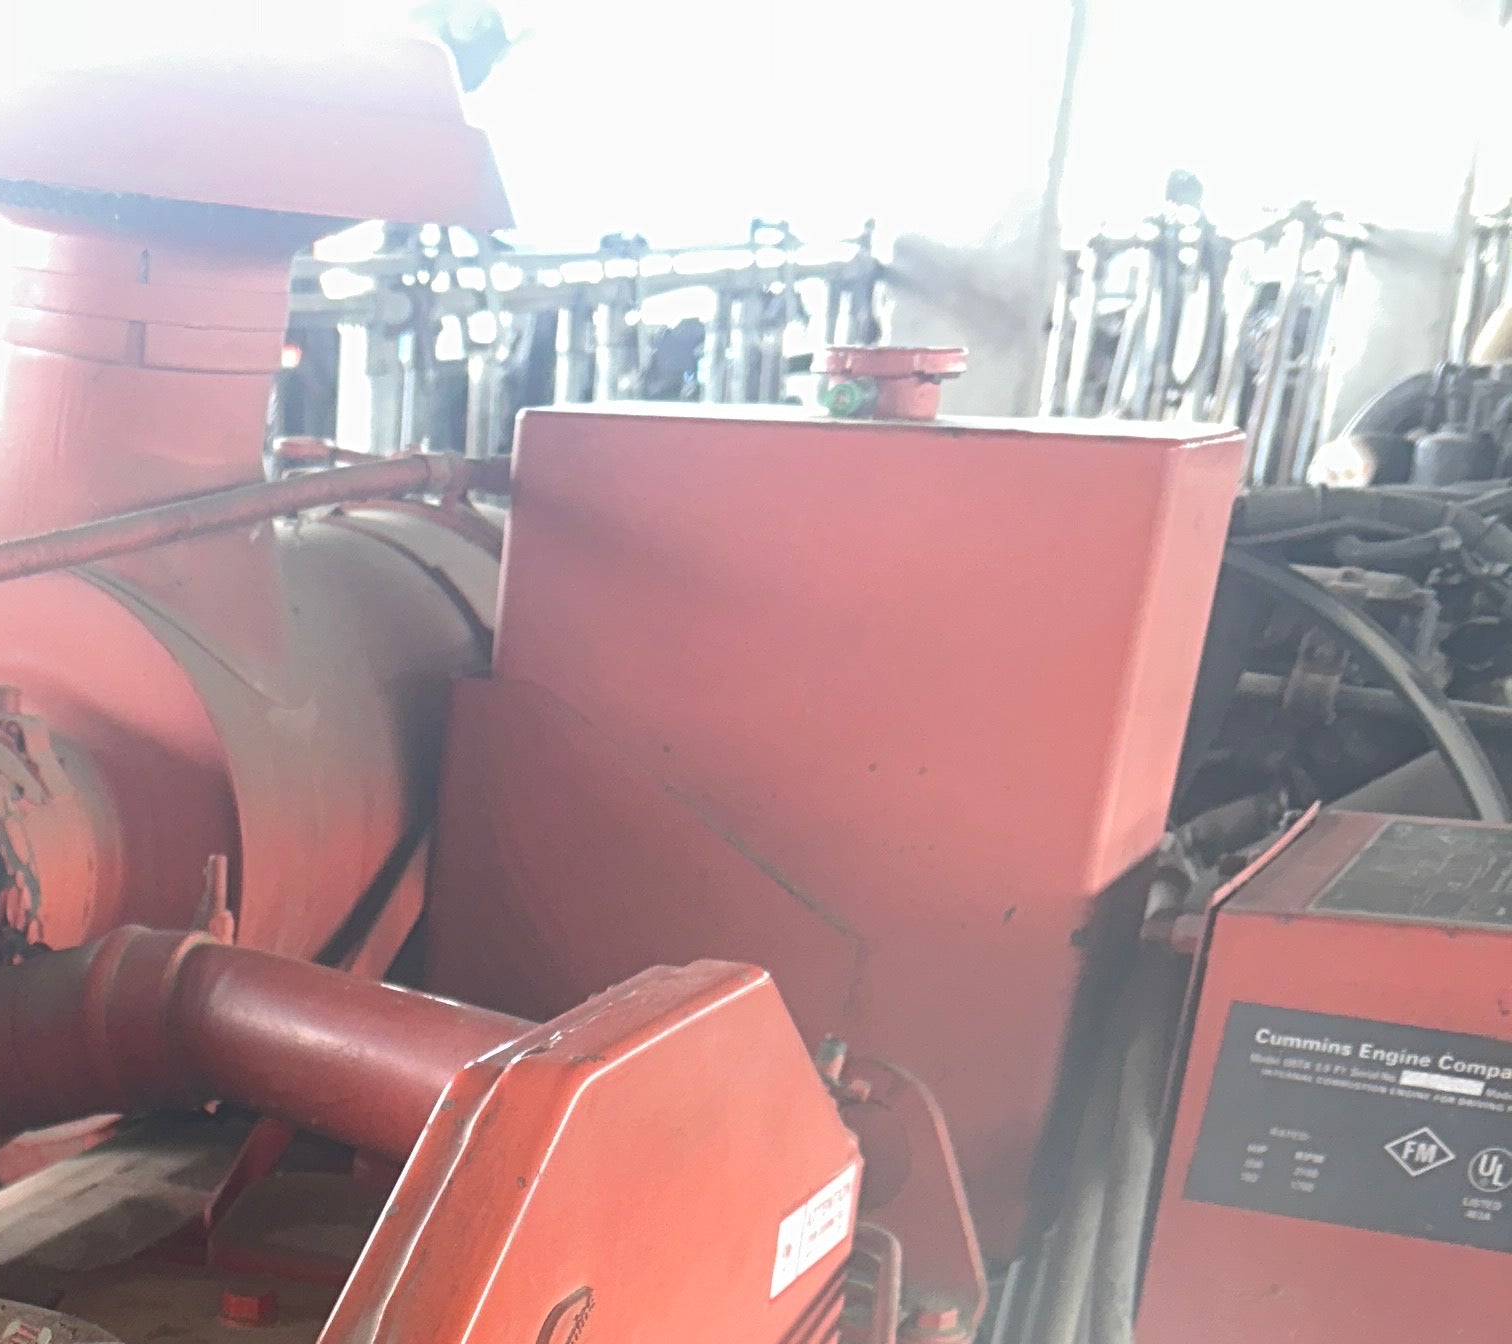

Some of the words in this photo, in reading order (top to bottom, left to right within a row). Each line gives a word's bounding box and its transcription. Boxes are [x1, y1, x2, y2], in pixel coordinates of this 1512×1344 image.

[1253, 1027, 1353, 1058] Cummins
[1358, 1042, 1432, 1068] Engine
[1437, 1054, 1512, 1080] Compa
[1400, 1140, 1439, 1164] FM
[1478, 1153, 1504, 1187] UL
